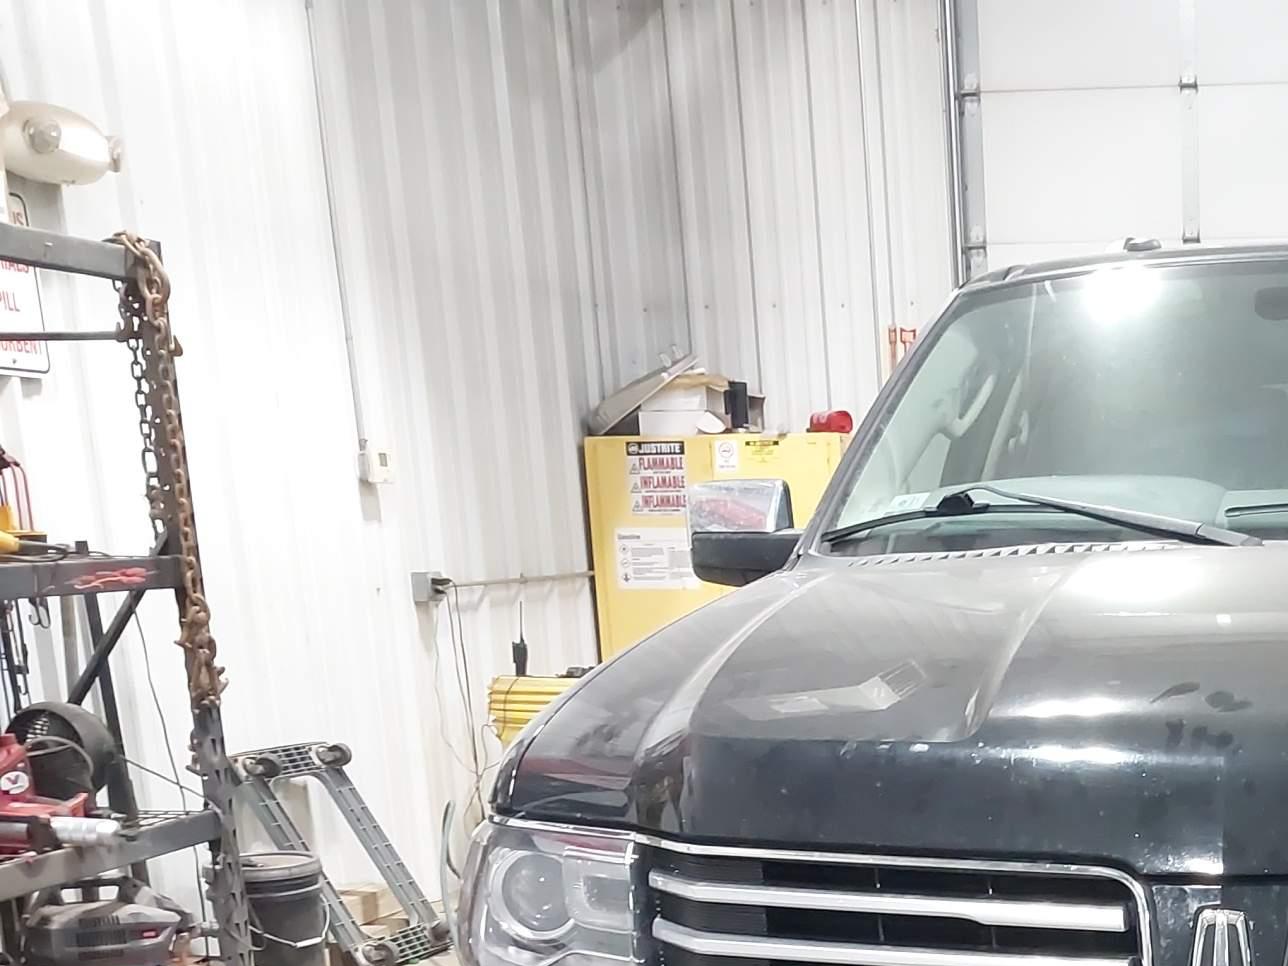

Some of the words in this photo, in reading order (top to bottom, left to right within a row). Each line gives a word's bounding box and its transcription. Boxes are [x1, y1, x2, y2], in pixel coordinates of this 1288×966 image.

[639, 443, 682, 454] JUSTRITE
[639, 457, 684, 470] FLAMMABLE
[640, 476, 685, 489] INFLAMABLE
[641, 495, 687, 508] INFLAMMABLE
